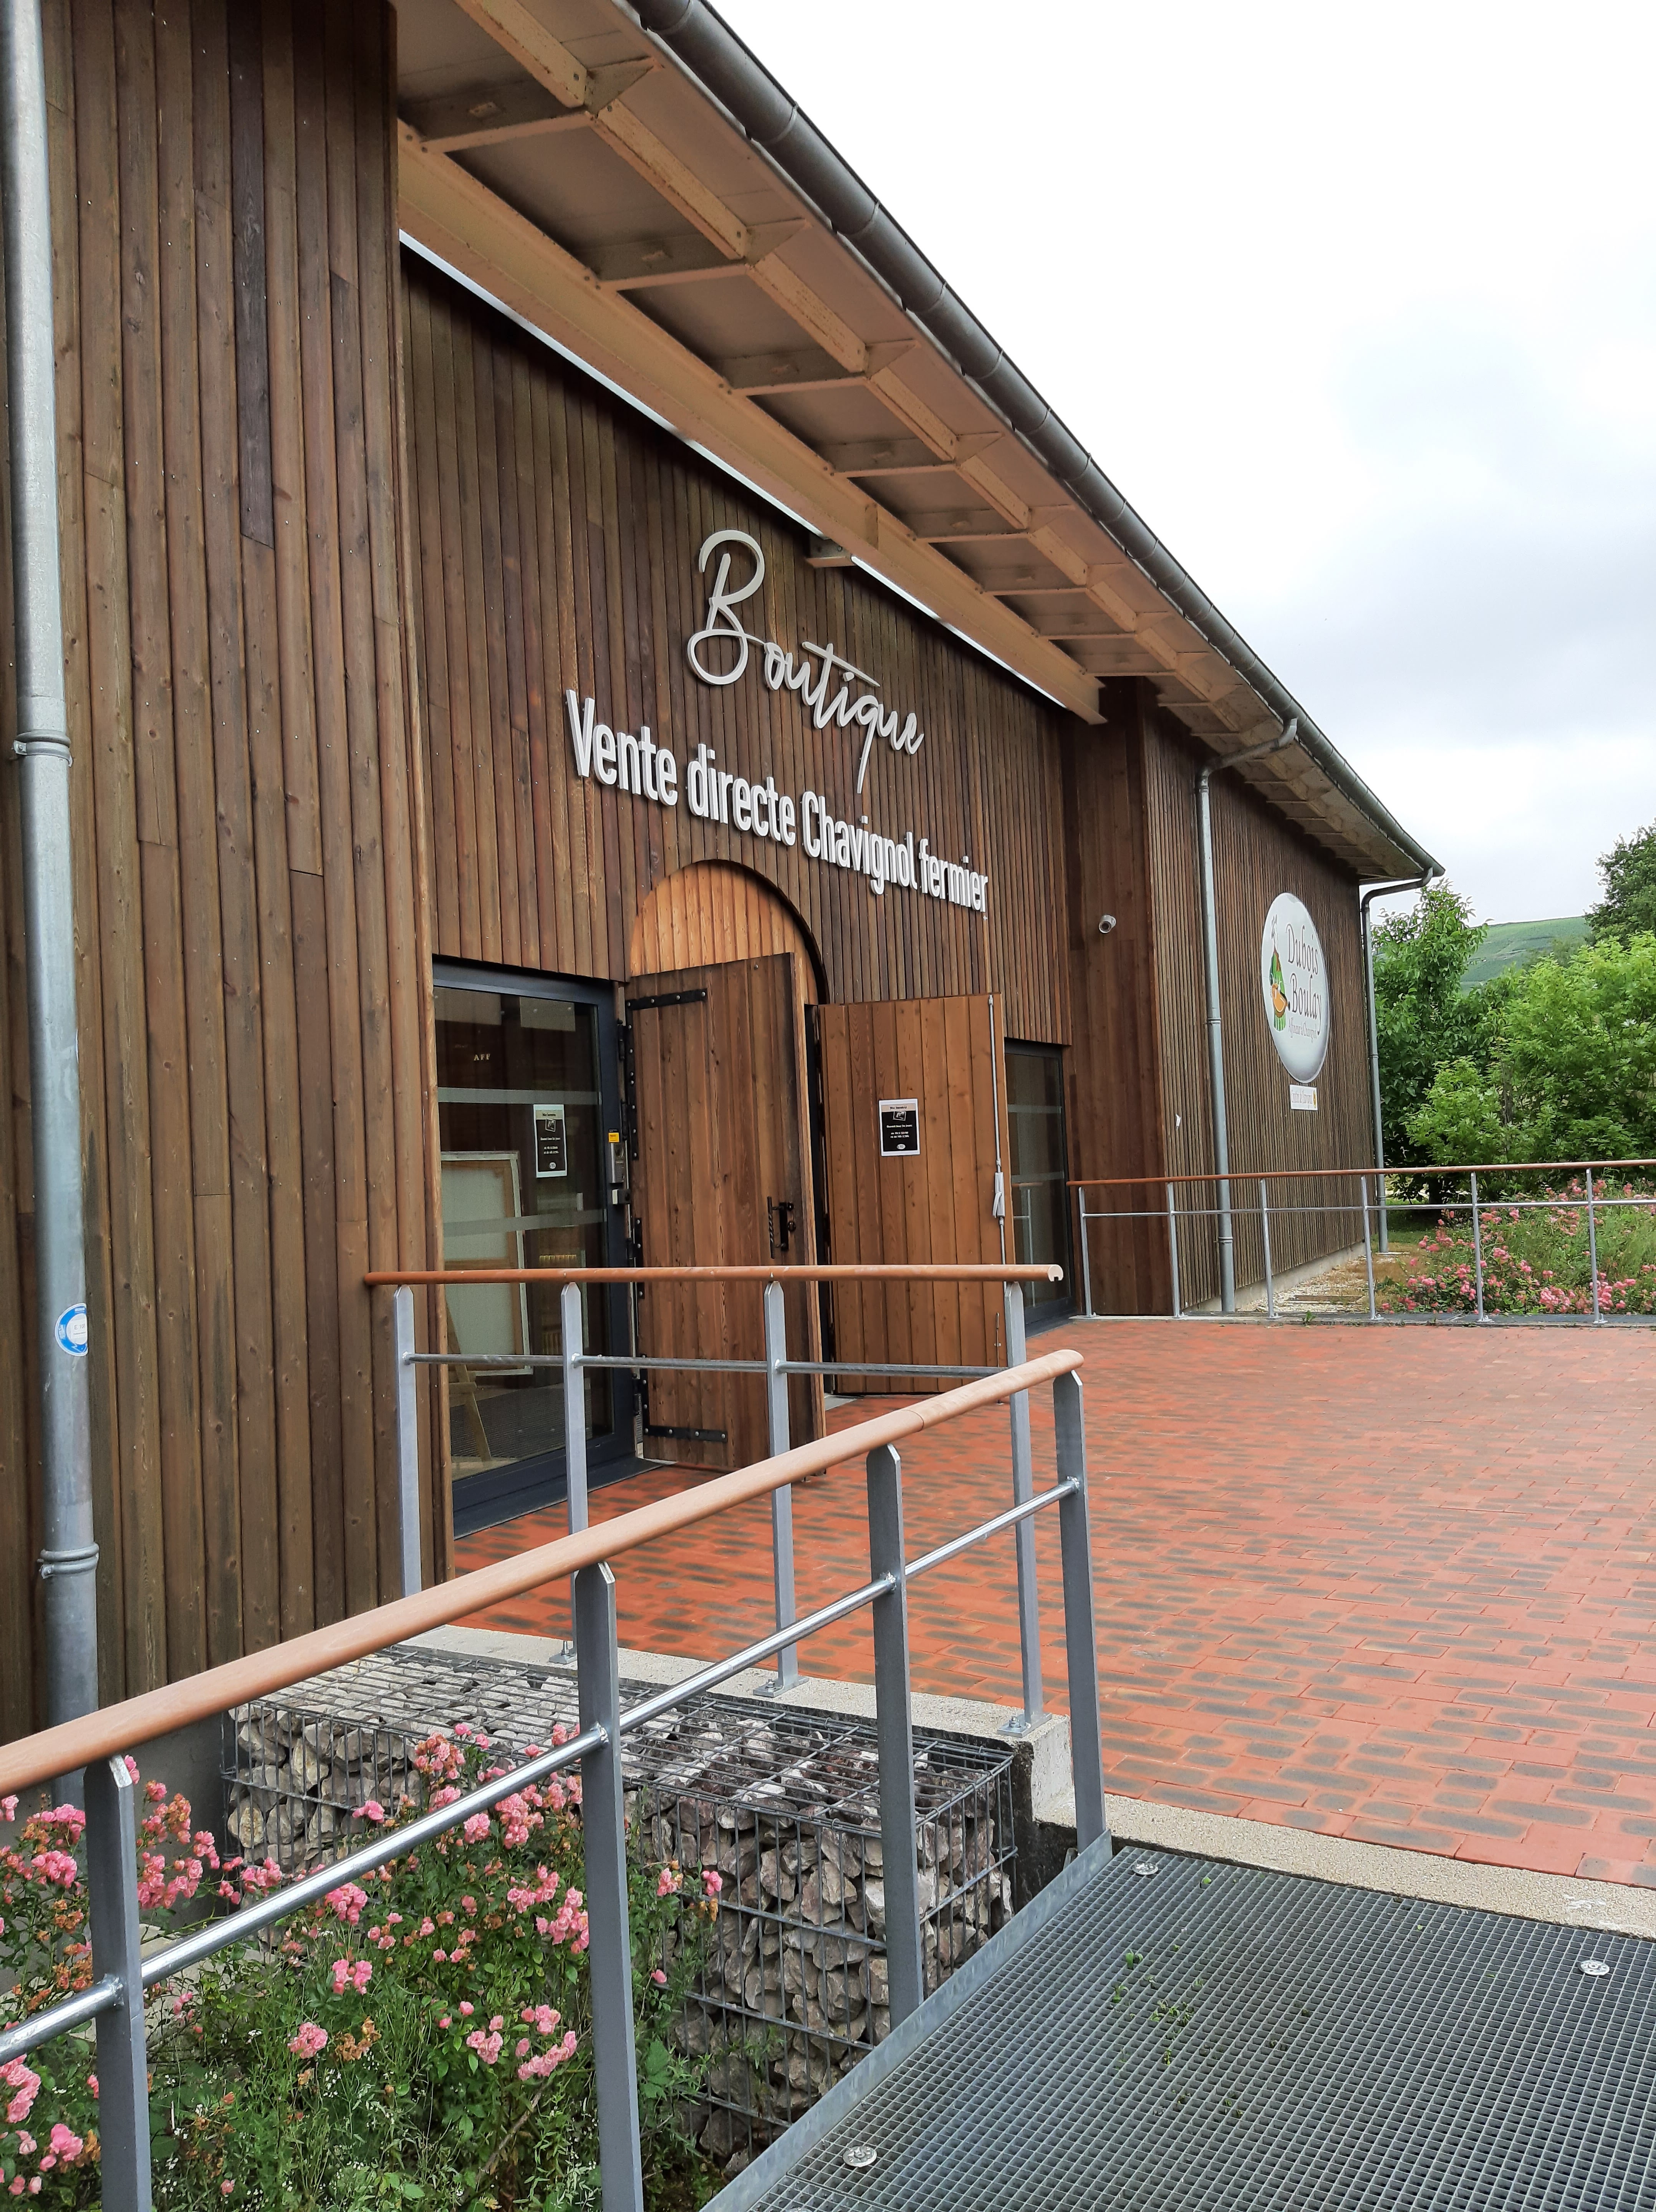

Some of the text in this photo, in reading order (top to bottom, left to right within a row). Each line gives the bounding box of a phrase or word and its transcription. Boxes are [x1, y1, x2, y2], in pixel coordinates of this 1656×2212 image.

[687, 530, 924, 794] Boutique
[566, 689, 988, 912] Vente directe Chavignol fermier
[1285, 923, 1318, 975] Dubois
[1290, 972, 1321, 1036] Boulay
